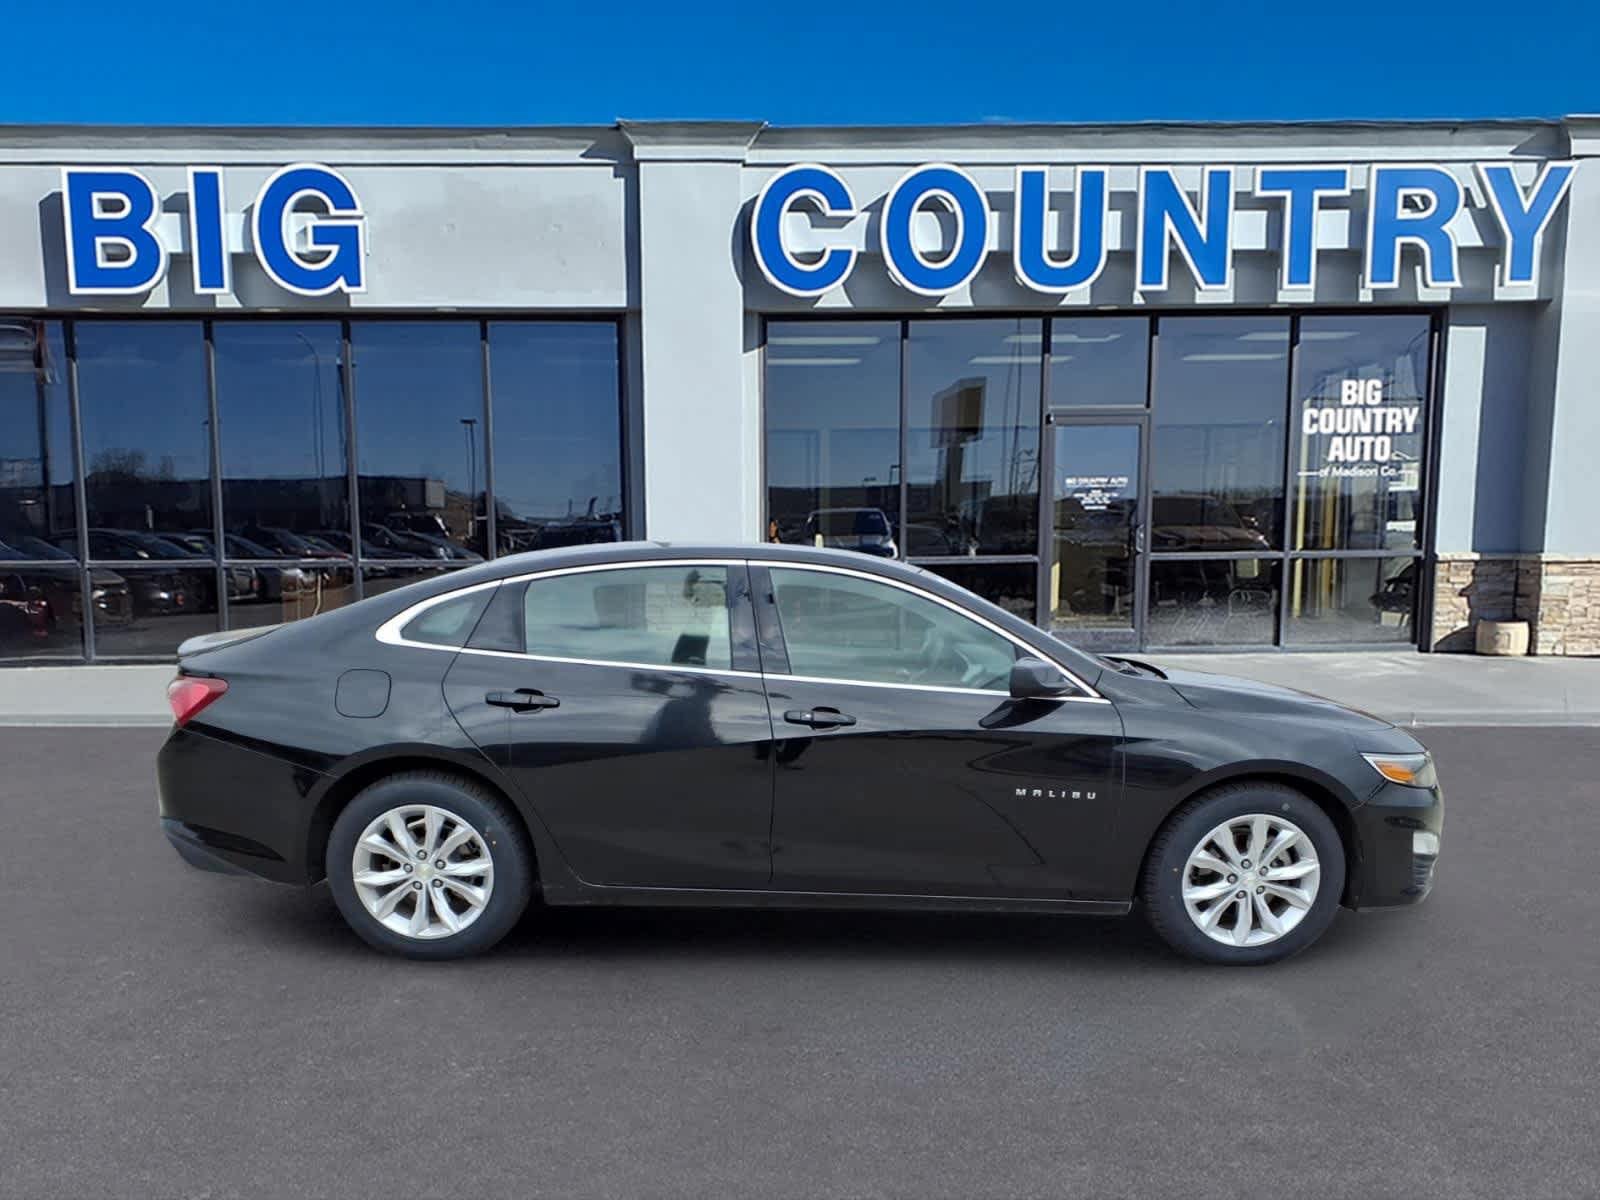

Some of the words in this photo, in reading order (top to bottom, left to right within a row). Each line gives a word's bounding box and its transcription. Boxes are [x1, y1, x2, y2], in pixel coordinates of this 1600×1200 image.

[61, 162, 367, 296] BIG
[750, 161, 1576, 297] COUNTRY
[1341, 379, 1382, 405] BIG
[1302, 408, 1419, 434] COUNTRY
[1328, 436, 1392, 461] AUTO
[1319, 466, 1329, 477] of
[1331, 466, 1378, 477] Madison
[1015, 788, 1096, 800] MALIBU
